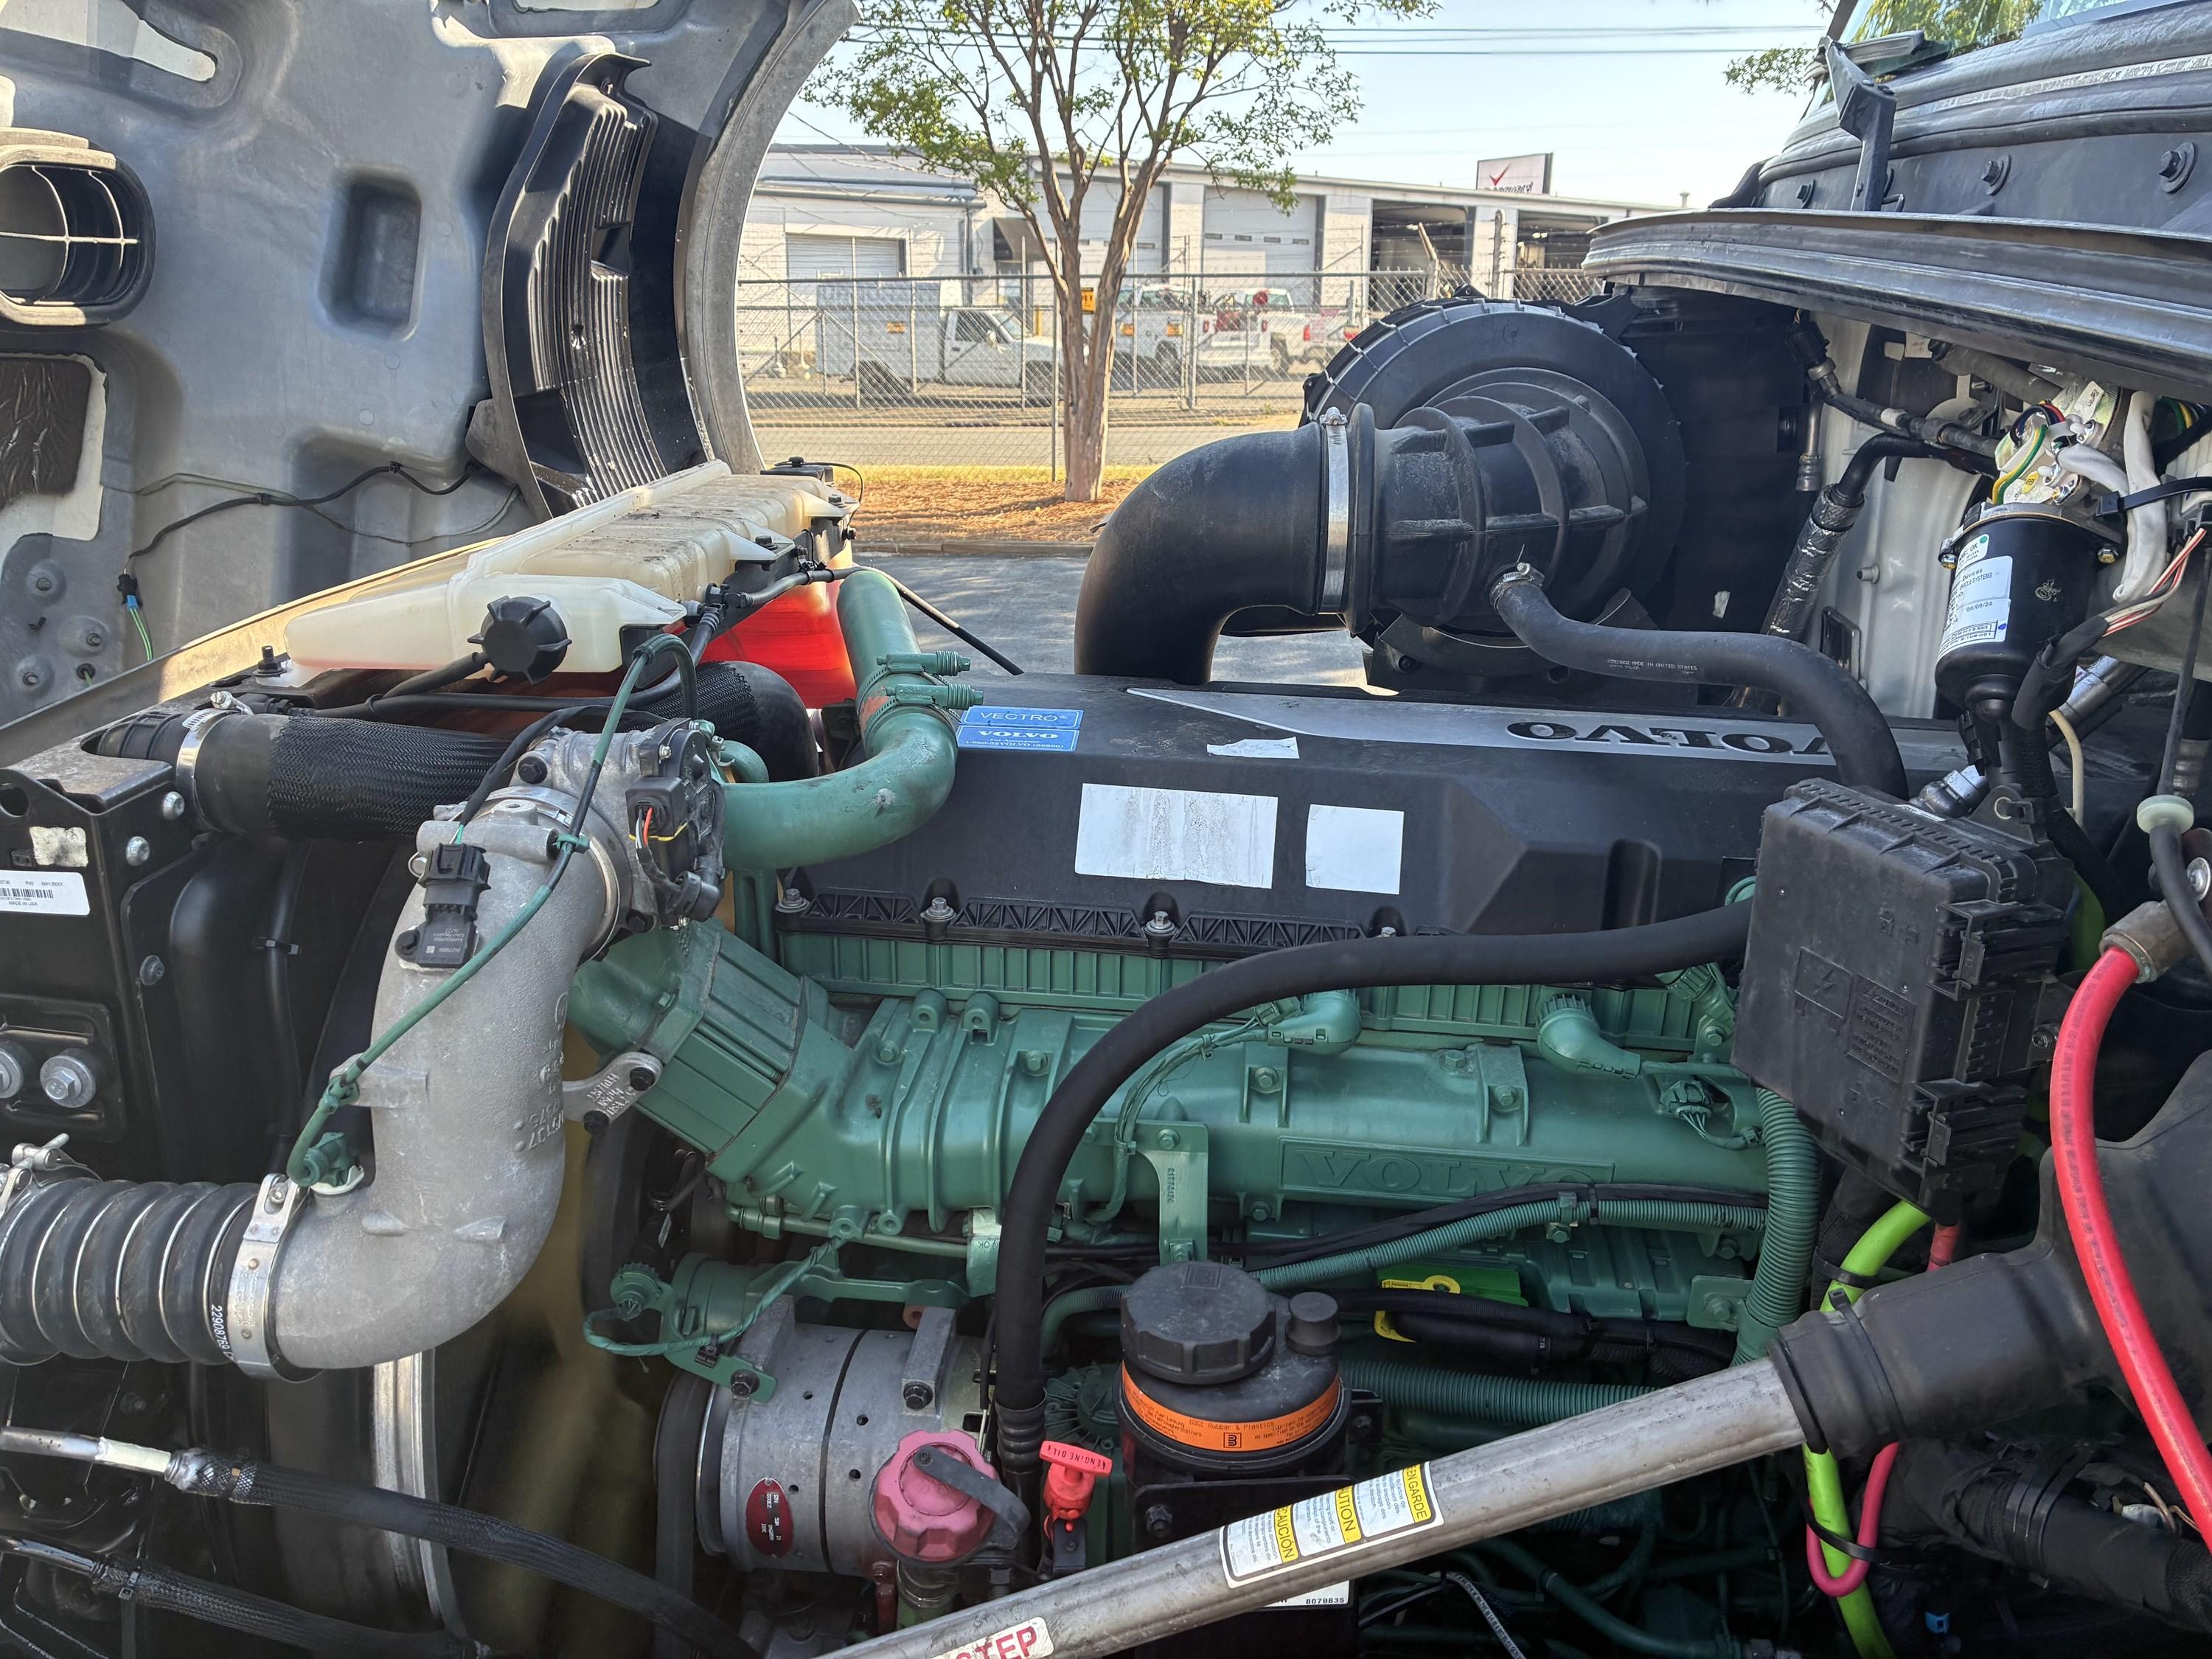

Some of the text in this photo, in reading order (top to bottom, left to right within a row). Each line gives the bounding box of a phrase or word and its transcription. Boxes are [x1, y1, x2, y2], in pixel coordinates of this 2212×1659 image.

[978, 731, 1058, 739] VOLVO
[211, 1304, 231, 1353] 22908769
[1208, 1421, 1232, 1431] Rubber
[1053, 1448, 1101, 1467] ENGINE OIL
[1409, 1481, 1427, 1518] GARDE
